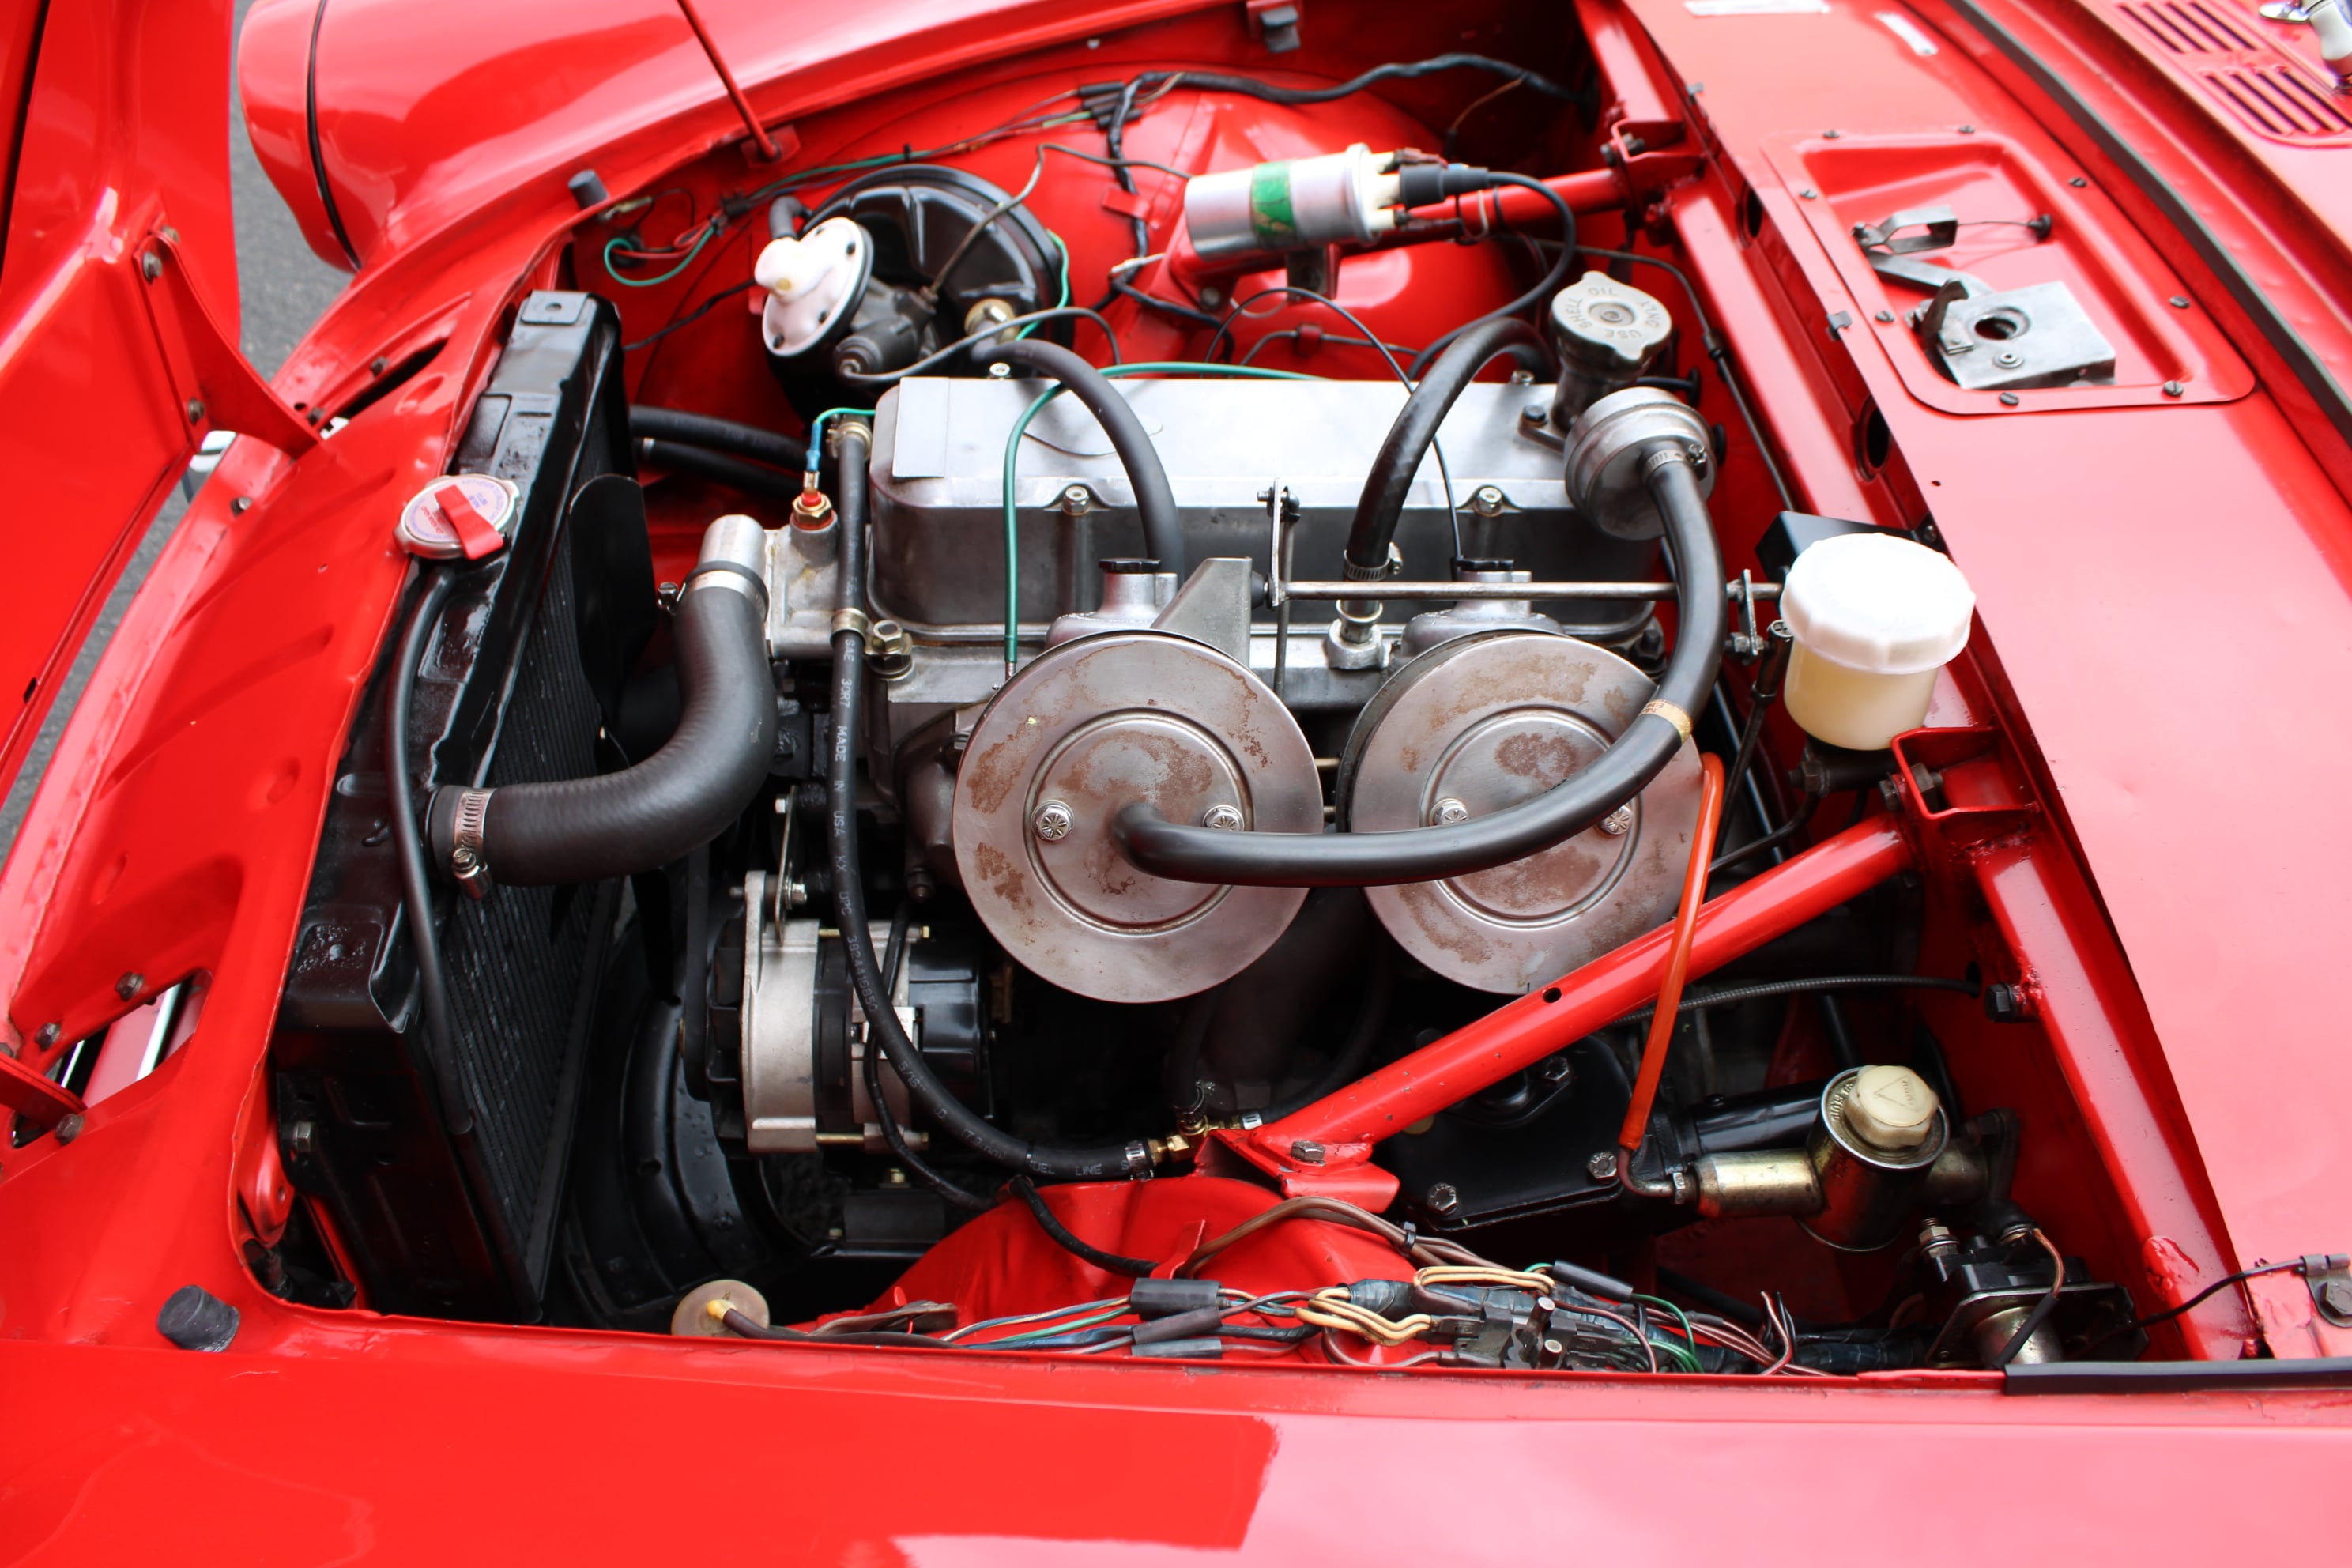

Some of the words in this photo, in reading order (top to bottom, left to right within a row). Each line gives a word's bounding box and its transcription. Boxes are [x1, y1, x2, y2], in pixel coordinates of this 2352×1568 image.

[1588, 287, 1618, 296] OIL
[1565, 297, 1593, 329] SHELL
[1638, 301, 1661, 328] ONLY
[1603, 329, 1643, 339] USE
[843, 639, 855, 662] SAE
[839, 678, 852, 708] 30R7
[835, 725, 847, 762] MADE
[834, 780, 846, 791] IN
[833, 810, 846, 838] USA
[835, 855, 846, 873] KX
[839, 891, 853, 917] UPC
[1075, 1163, 1103, 1177] LINE
